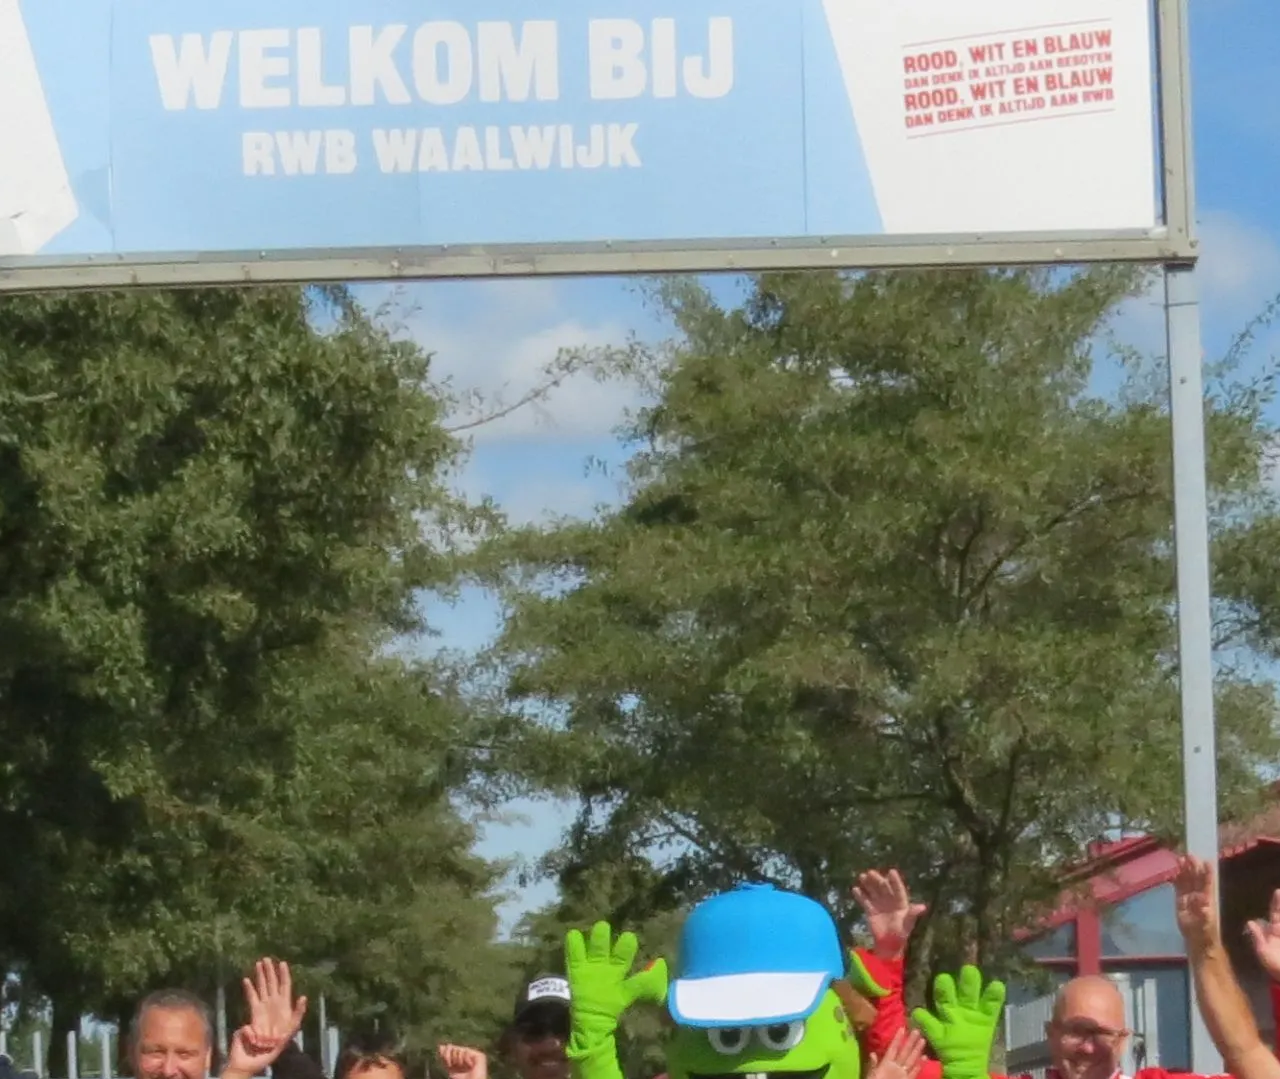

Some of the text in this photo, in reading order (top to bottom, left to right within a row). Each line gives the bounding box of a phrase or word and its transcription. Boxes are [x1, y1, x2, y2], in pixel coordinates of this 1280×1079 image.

[149, 17, 734, 110] WELKOM BIJ
[969, 42, 1005, 64] WIT
[1013, 39, 1038, 58] EN
[1043, 30, 1112, 54] BLAUW
[904, 76, 929, 89] DAN
[932, 71, 964, 85] DENK
[970, 68, 980, 80] IK
[984, 62, 1025, 77] ALTIJD
[1029, 60, 1053, 72] AAN
[970, 80, 1006, 101] WIT
[1014, 76, 1039, 95] EN
[1045, 67, 1113, 91] BLAUW
[905, 88, 1114, 128] DAN DENK IK ALTIJD AAN RWB
[242, 123, 642, 176] RWB WAALWIJK
